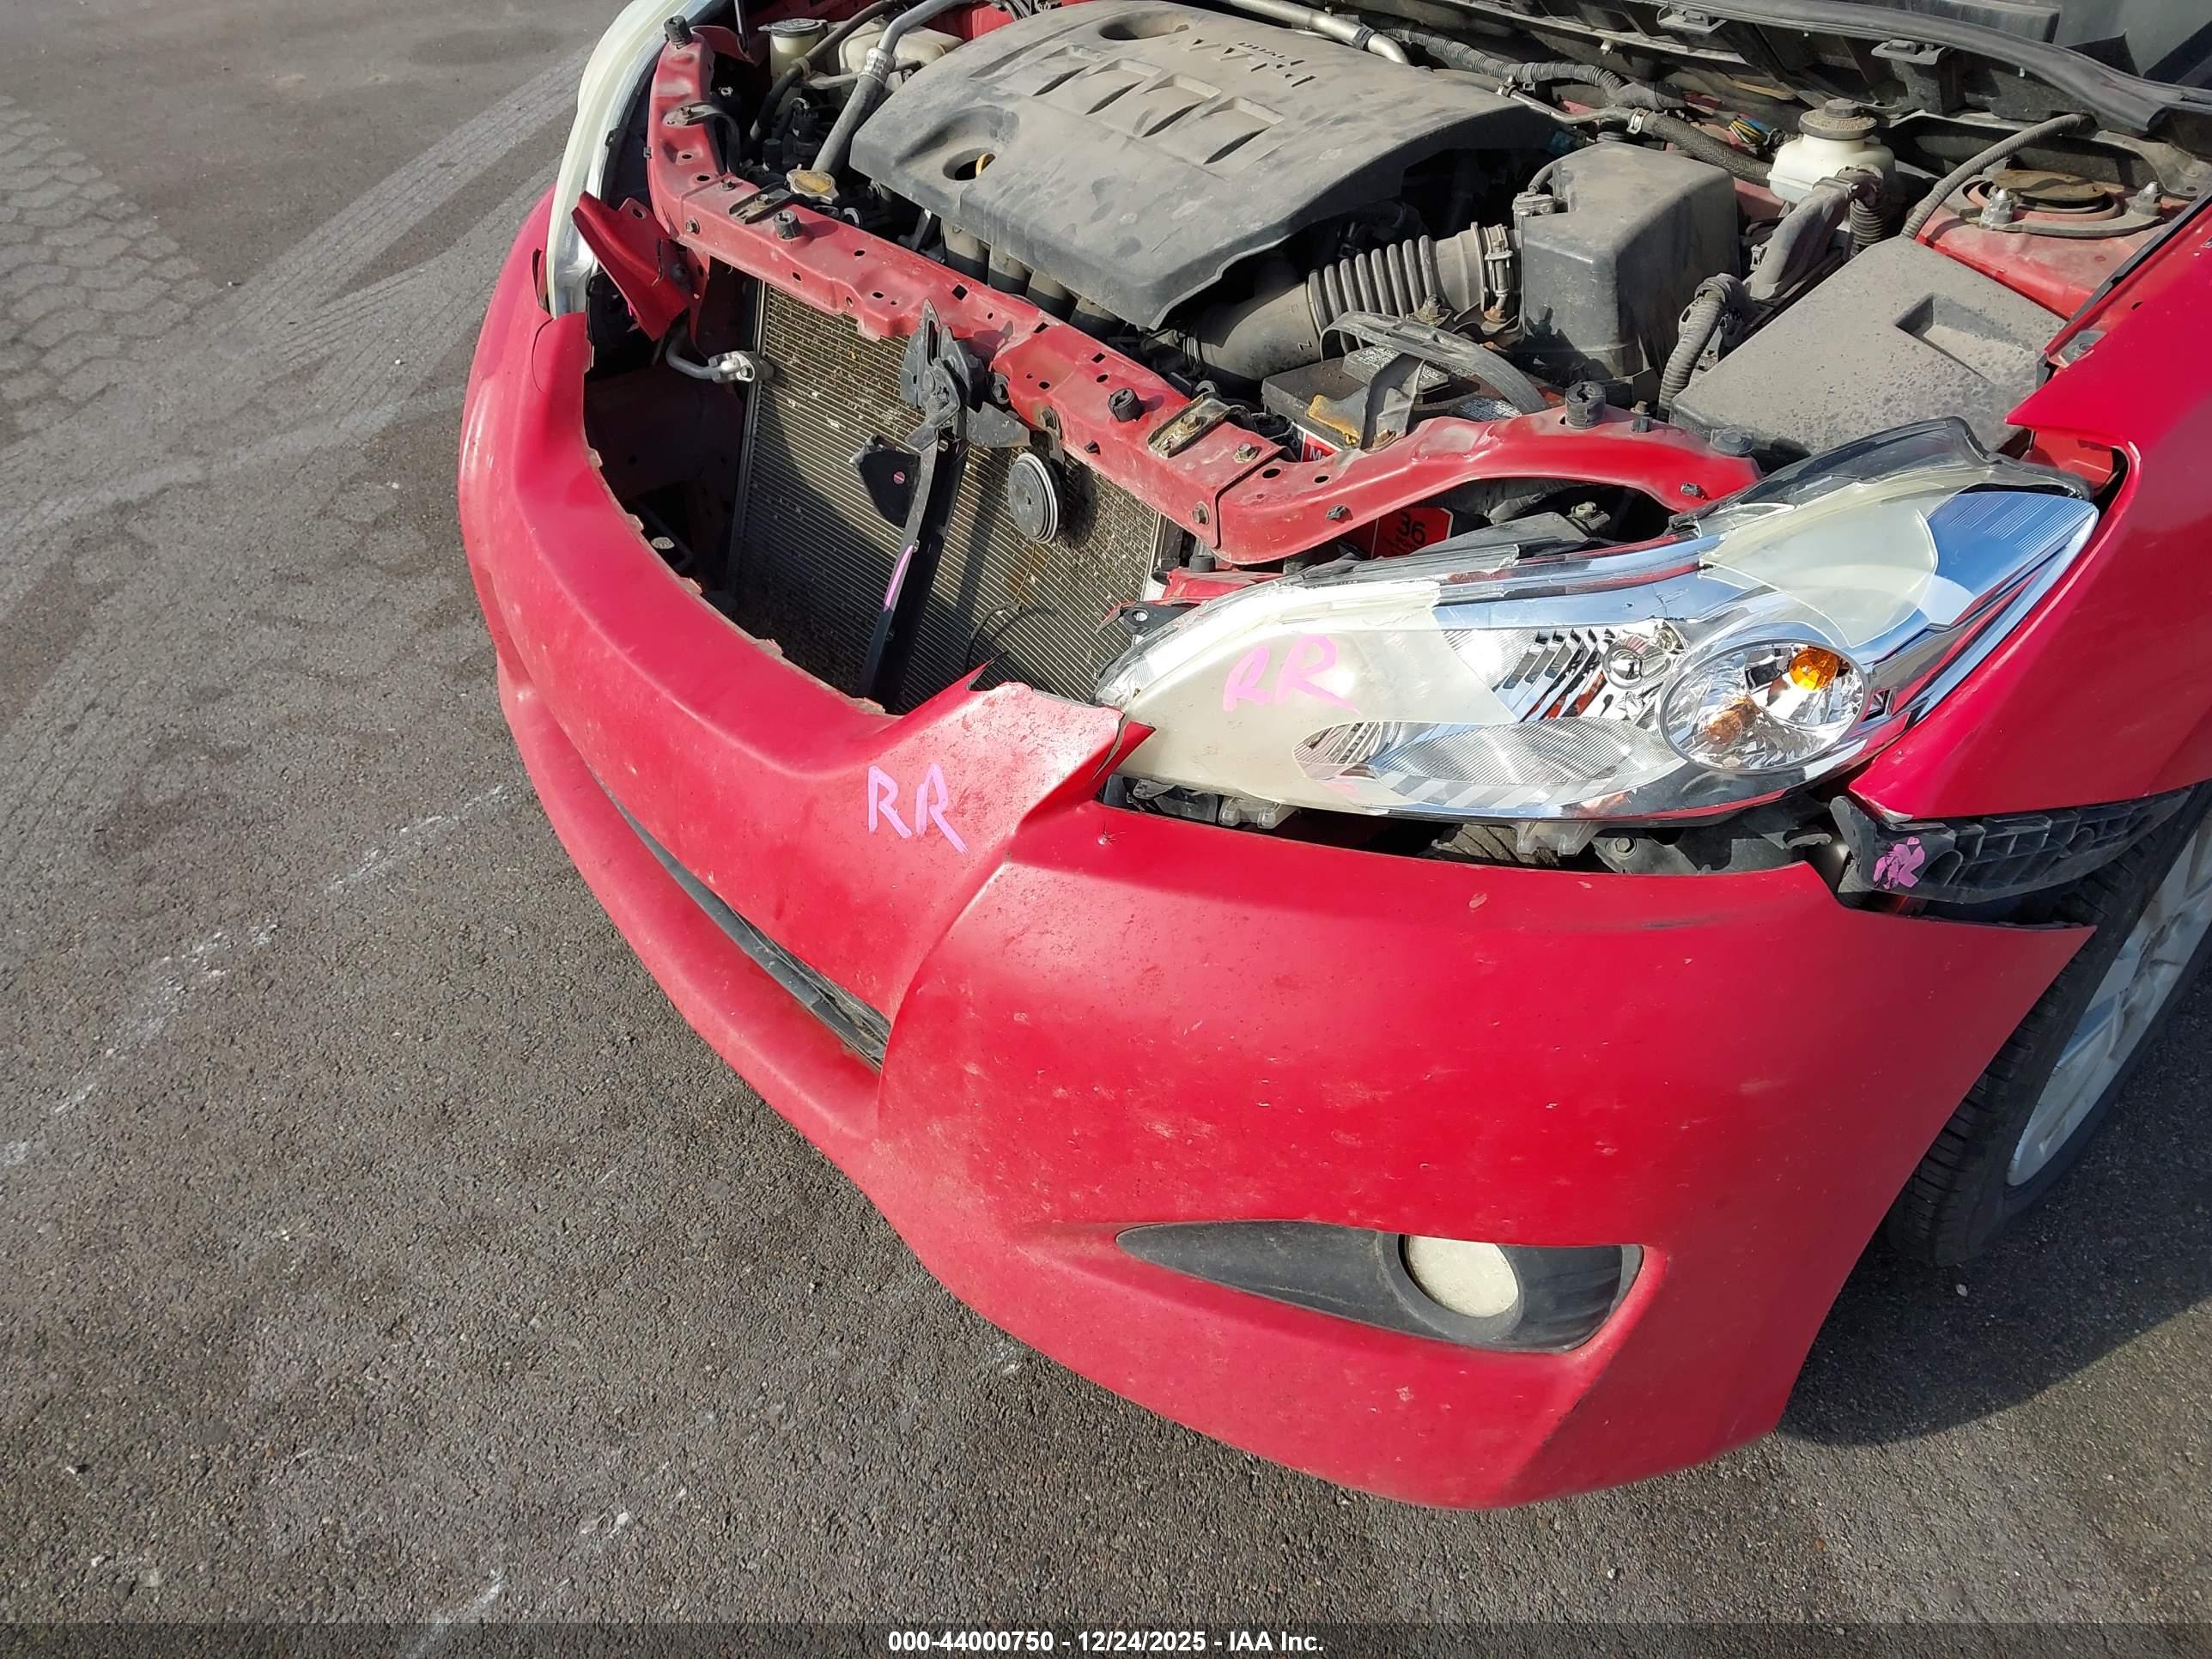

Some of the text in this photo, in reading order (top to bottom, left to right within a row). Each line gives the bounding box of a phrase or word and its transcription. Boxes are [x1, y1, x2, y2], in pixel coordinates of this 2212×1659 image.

[1395, 510, 1426, 545] 36
[1222, 634, 1361, 715] RR
[867, 762, 969, 856] RR
